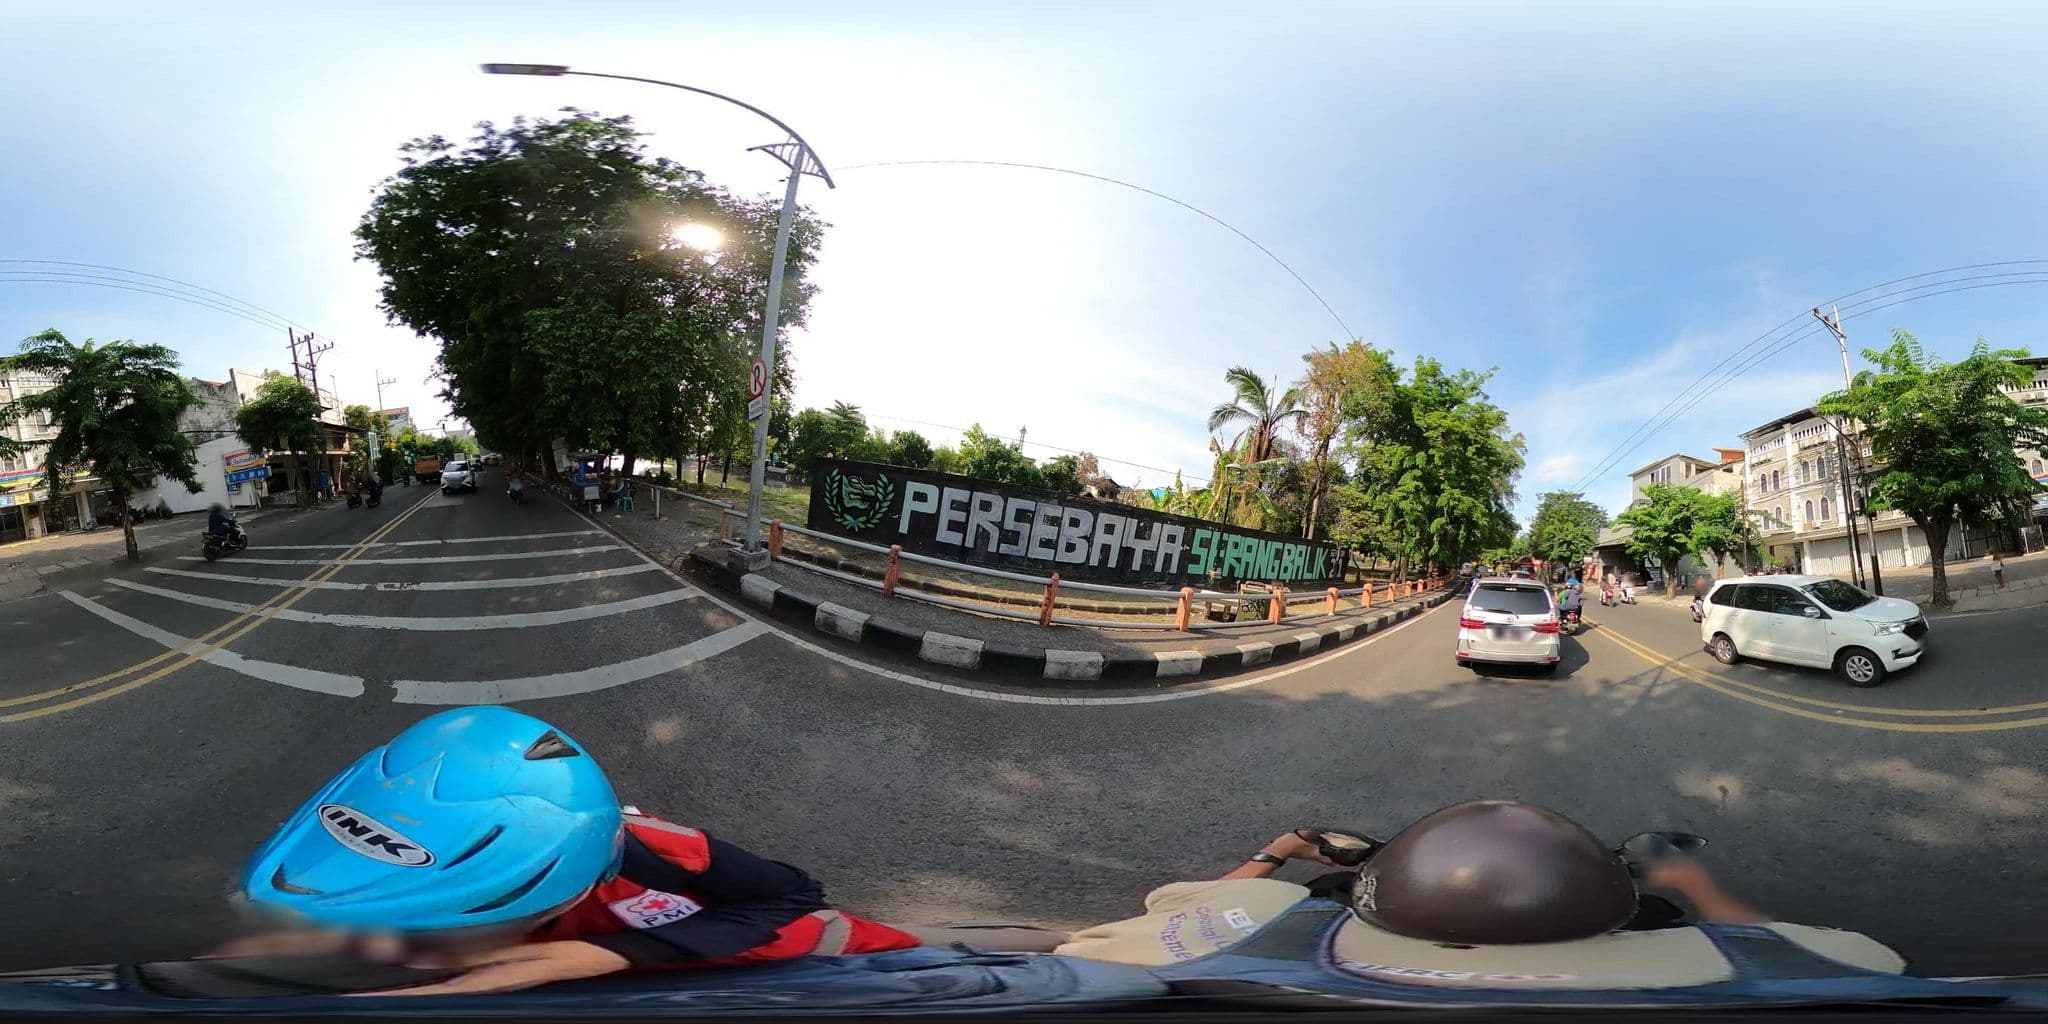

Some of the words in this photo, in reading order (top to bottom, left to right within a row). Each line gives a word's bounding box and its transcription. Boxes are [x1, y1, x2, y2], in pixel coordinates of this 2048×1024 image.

[898, 480, 1186, 575] PERSEBAYA
[326, 809, 422, 858] INK
[642, 904, 694, 926] PMI
